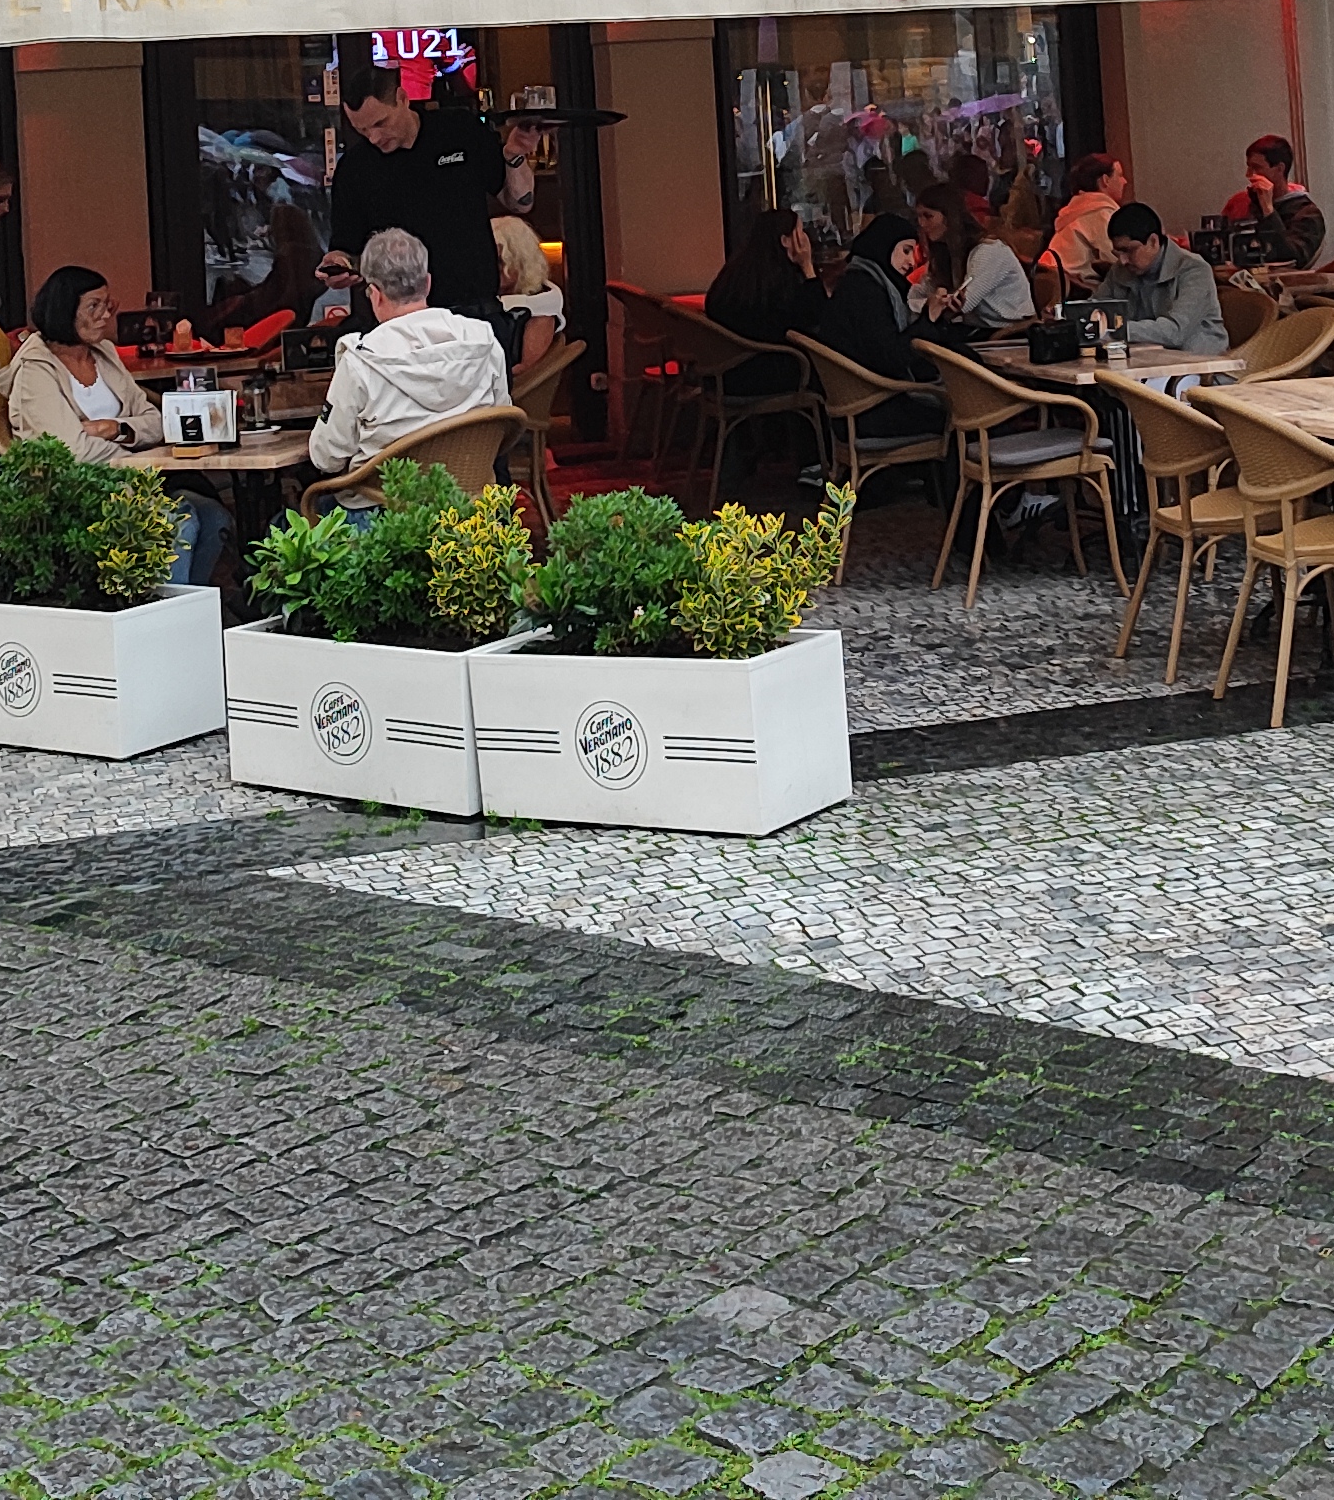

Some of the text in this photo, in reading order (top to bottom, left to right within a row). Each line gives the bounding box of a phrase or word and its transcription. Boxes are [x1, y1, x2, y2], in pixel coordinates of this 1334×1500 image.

[396, 28, 464, 59] U21
[4, 672, 32, 706] 1882
[327, 716, 361, 752] 1882
[579, 717, 632, 755] VERGNANO
[595, 736, 634, 778] 1882
